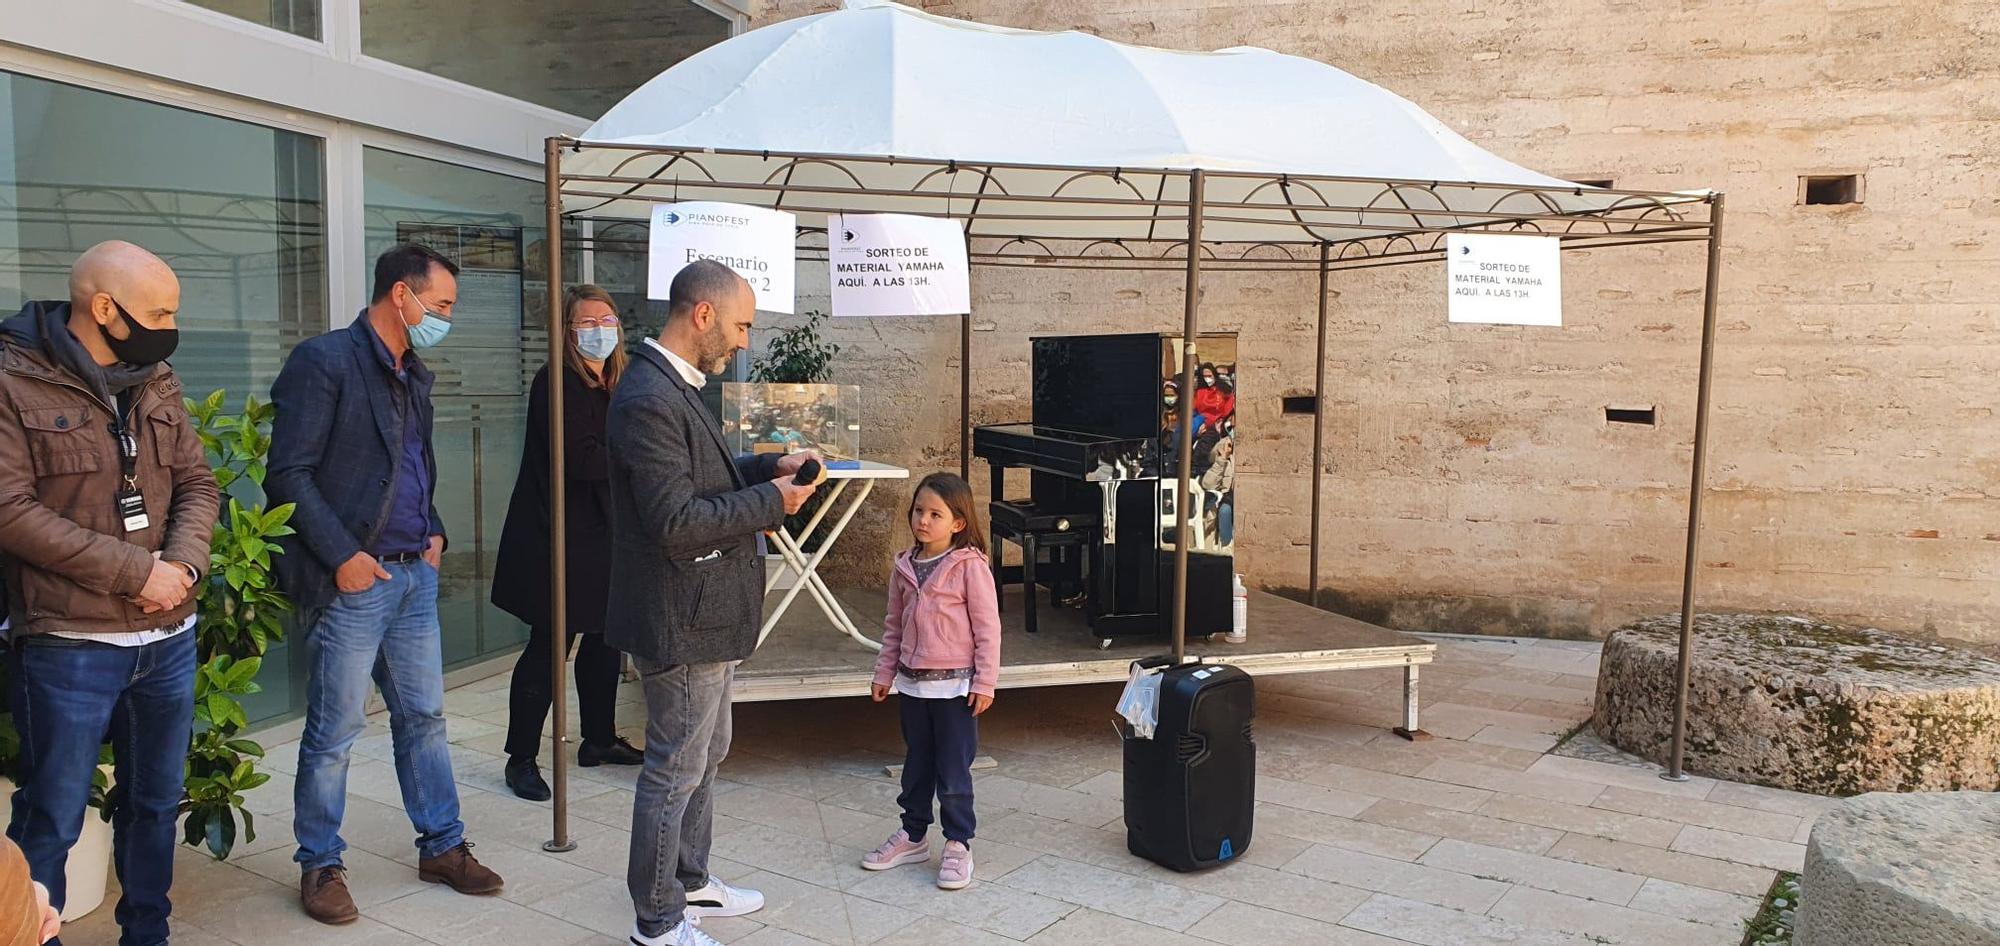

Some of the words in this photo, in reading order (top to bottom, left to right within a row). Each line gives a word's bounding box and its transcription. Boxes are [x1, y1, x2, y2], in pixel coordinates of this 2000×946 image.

[688, 213, 750, 226] PIANOFEST
[866, 248, 911, 258] SORTEO
[914, 247, 929, 257] DE
[685, 248, 768, 272] Escenario
[837, 263, 892, 273] MATERIAL
[898, 262, 945, 272] YAMAHA
[1480, 262, 1516, 272] SORTEO
[1518, 265, 1530, 273] DE
[762, 277, 771, 292] 2
[873, 278, 881, 287] A
[884, 277, 905, 287] LAS
[909, 277, 931, 287] 13H.
[1455, 274, 1501, 284] MATERIAL
[1506, 276, 1542, 286] YAMAHA
[1494, 289, 1511, 298] LAS
